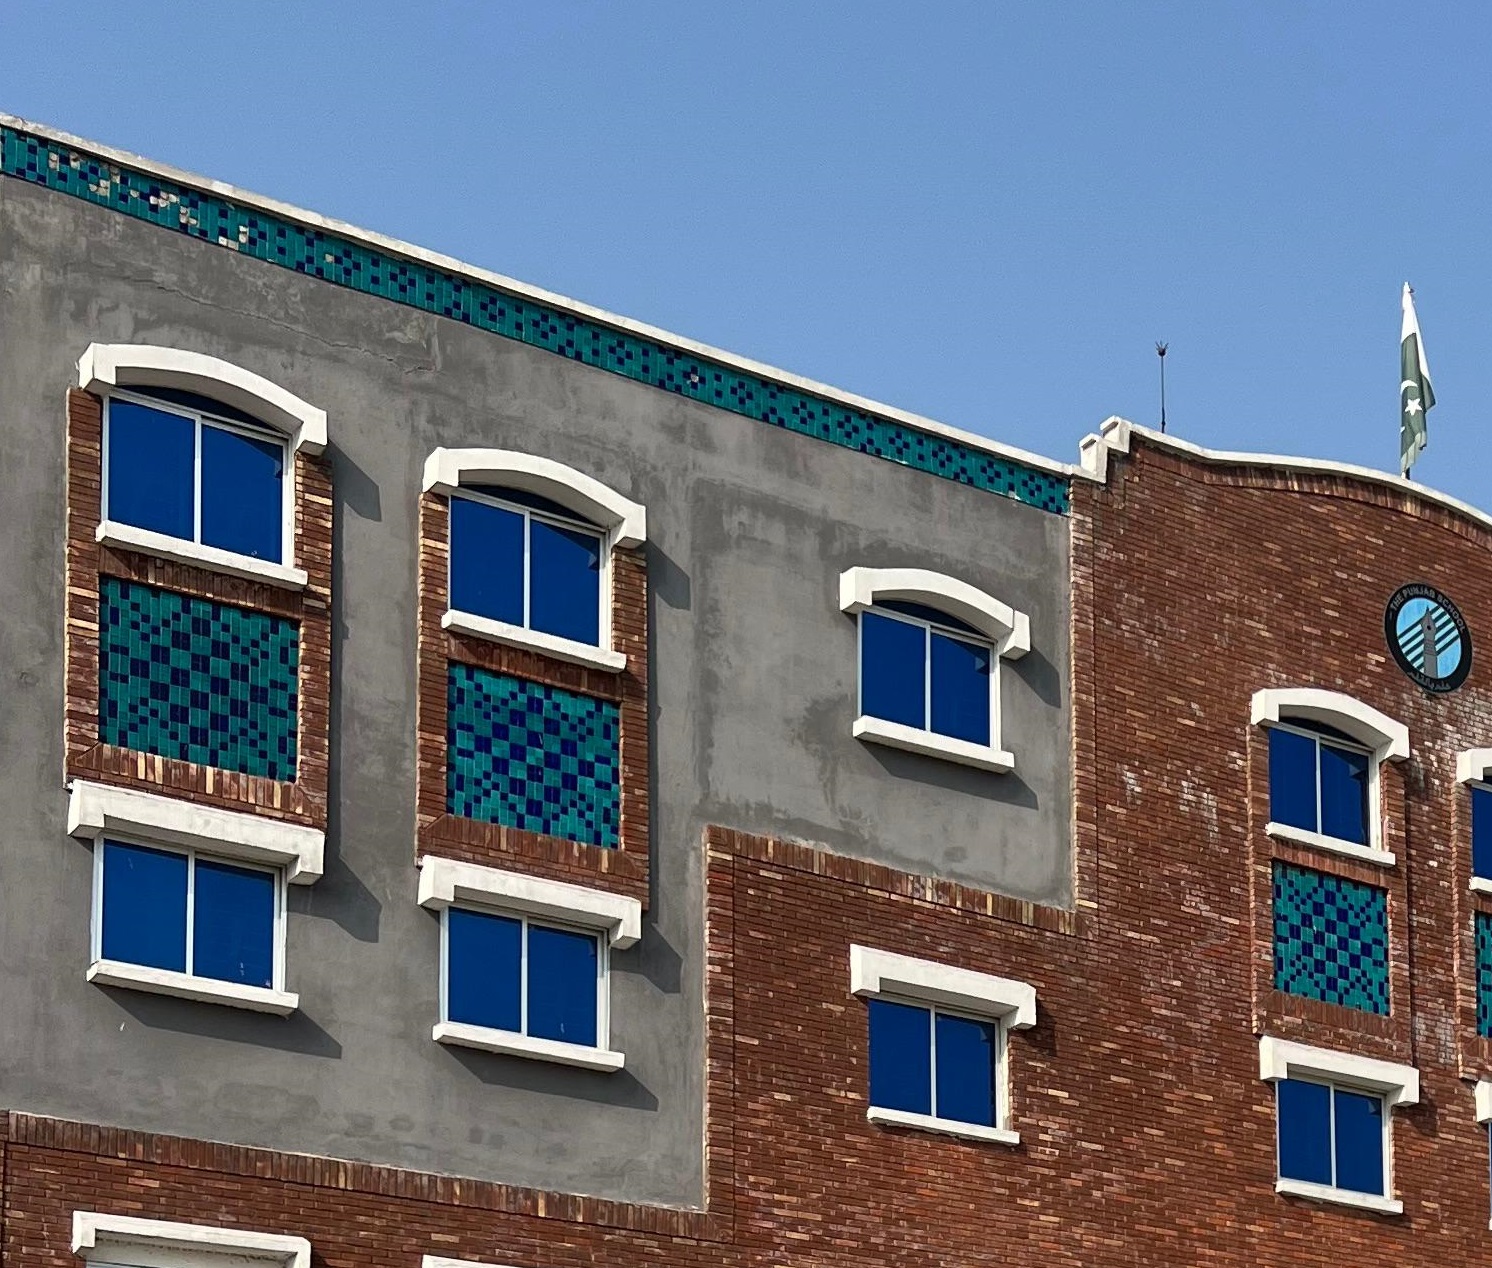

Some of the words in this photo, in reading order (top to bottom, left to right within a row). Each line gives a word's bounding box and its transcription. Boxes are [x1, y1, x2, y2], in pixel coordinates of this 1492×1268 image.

[1390, 593, 1404, 611] THE
[1402, 586, 1436, 598] PUNJAB
[1436, 594, 1466, 633] SCHOOL
